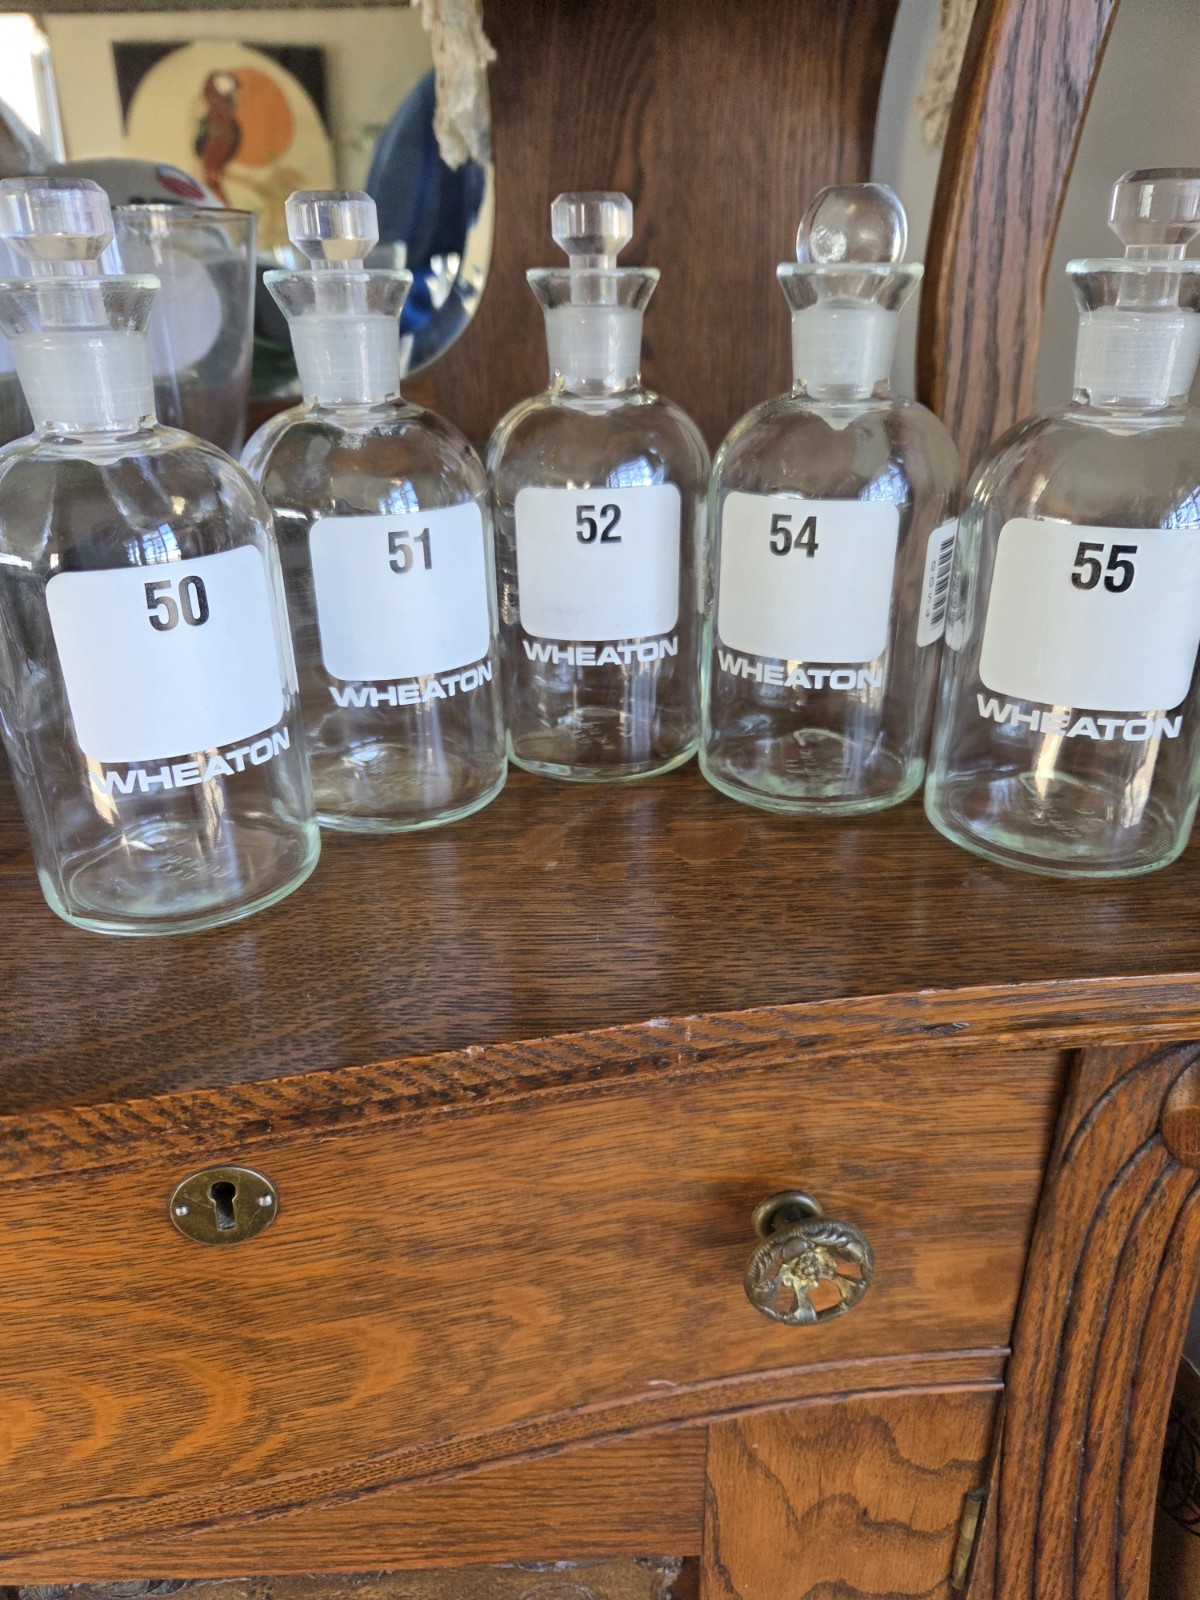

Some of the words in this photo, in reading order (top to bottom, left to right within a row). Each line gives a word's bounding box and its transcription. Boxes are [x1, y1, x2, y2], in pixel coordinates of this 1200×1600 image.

[575, 503, 622, 544] 52
[769, 513, 819, 558] 54
[387, 527, 432, 574] 51
[1071, 541, 1138, 593] 55
[144, 575, 210, 631] 50
[522, 636, 678, 666] WHEATON
[718, 650, 883, 690] WHEATON
[328, 661, 493, 708] WHEATON
[977, 693, 1183, 741] WHEATON
[90, 727, 290, 794] WHEATON
